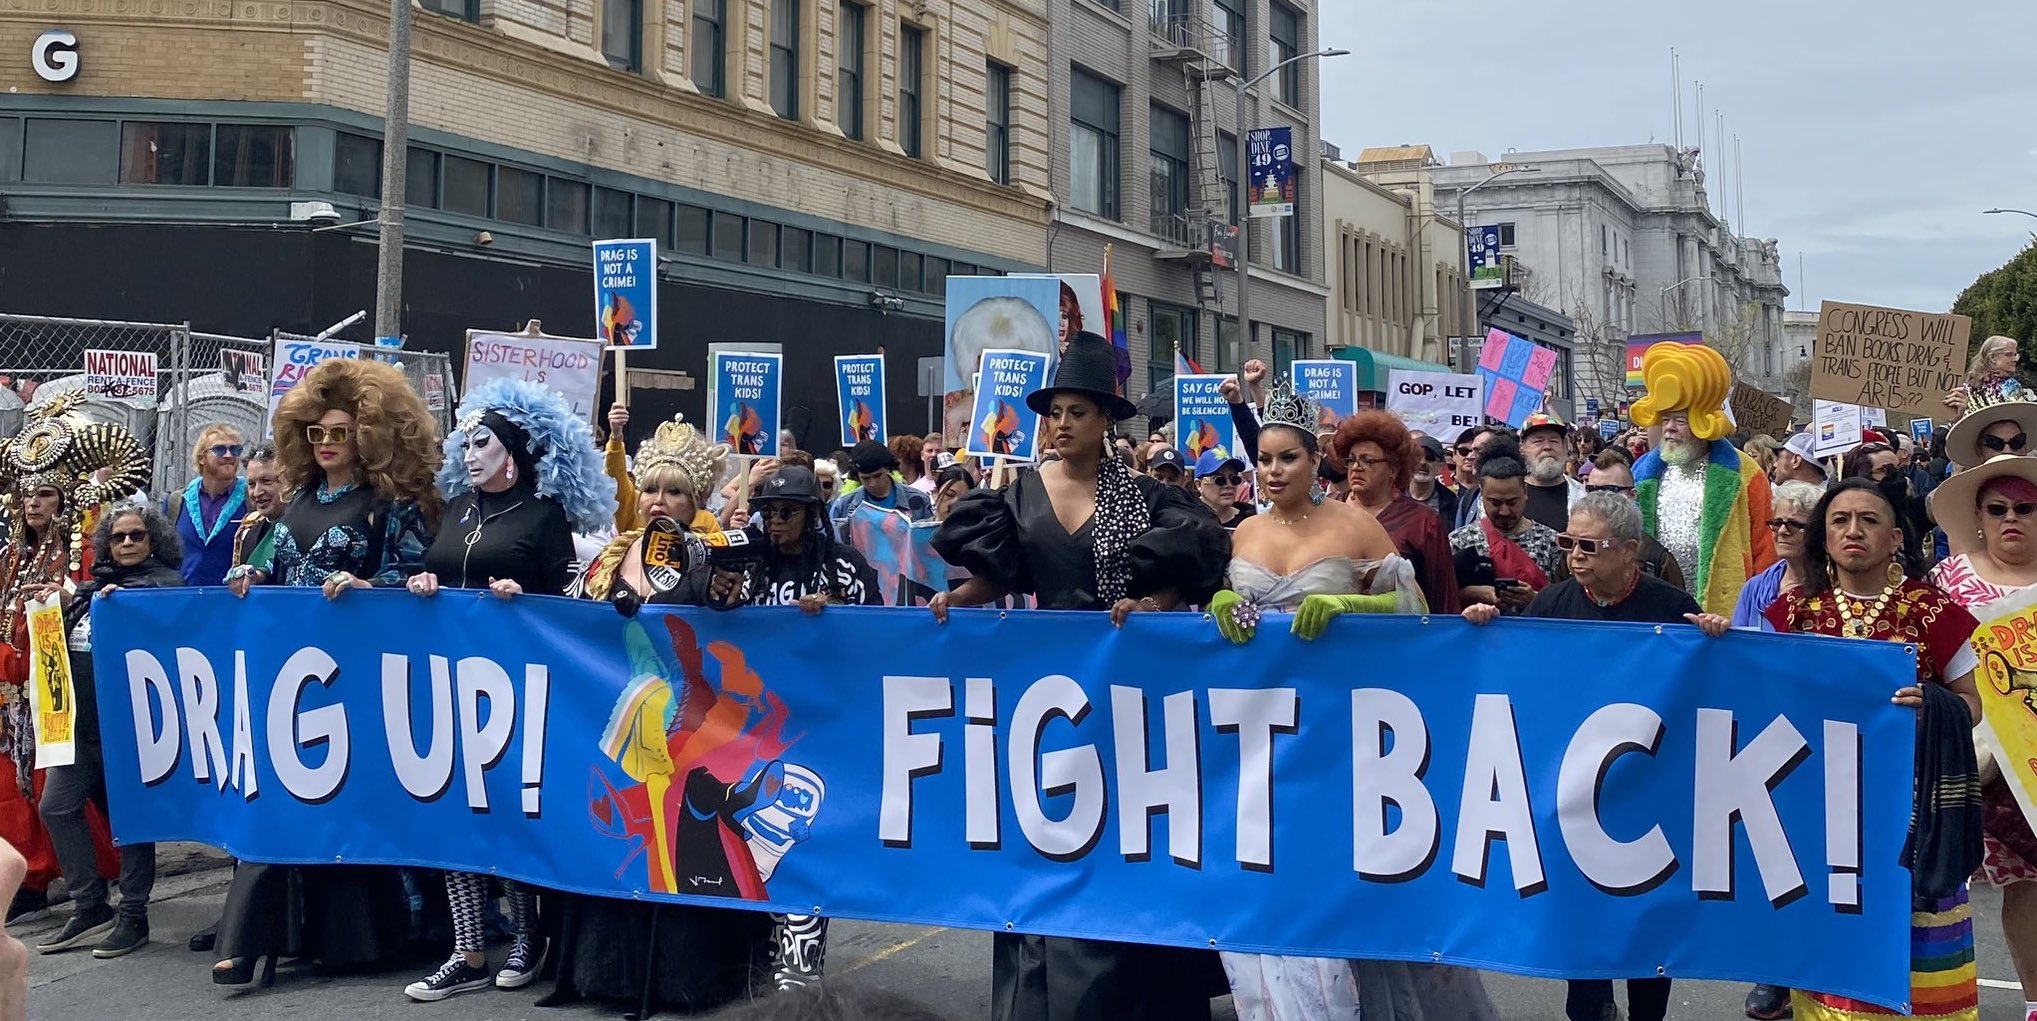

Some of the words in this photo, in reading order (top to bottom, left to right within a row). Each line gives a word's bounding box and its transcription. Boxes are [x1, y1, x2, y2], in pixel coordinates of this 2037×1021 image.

[32, 29, 79, 82] G
[1250, 141, 1271, 154] DINE
[1251, 153, 1272, 167] 49
[600, 249, 624, 261] DRAG
[627, 248, 638, 260] IS
[603, 263, 622, 275] NOT
[625, 262, 633, 274] A
[602, 276, 636, 288] CRIME!
[1827, 308, 1912, 339] CONGRESS
[1921, 317, 1956, 345] WILL
[472, 341, 588, 370] SISTERHOOD
[1825, 333, 1857, 356] BAN
[1906, 343, 1940, 367] DRAG
[87, 352, 155, 377] NATIONAL
[725, 361, 770, 374] PROTECT
[842, 363, 875, 374] PROTECT
[989, 357, 1035, 373] PROTECT
[524, 370, 547, 383] IS
[993, 371, 1027, 385] TRANS
[1304, 367, 1330, 378] DRAG
[1332, 367, 1342, 378] IS
[1822, 356, 1862, 379] TRANS
[1867, 362, 1902, 385] PEOPLE
[1907, 367, 1932, 387] BUT
[1935, 373, 1962, 392] NOT
[87, 376, 155, 386] RENT-A-FENCE
[731, 374, 764, 387] TRANS
[847, 374, 872, 385] TRANS
[1308, 379, 1329, 389] NOT
[1331, 379, 1338, 389] A
[734, 387, 762, 400] KIDS!
[850, 386, 871, 396] KIDS!
[994, 384, 1023, 398] KIDS!
[1182, 383, 1203, 394] SAY
[1204, 383, 1219, 394] GA
[1399, 382, 1437, 399] GOP,
[1445, 386, 1477, 399] LET
[1181, 396, 1194, 404] WE
[1195, 396, 1213, 405] WILL
[1181, 406, 1191, 415] BE
[1191, 406, 1229, 416] SILENCED!
[1451, 414, 1479, 428] BE!
[124, 645, 350, 803] DRAG
[381, 651, 551, 819] UP!
[877, 674, 1300, 872] FIGHT
[1351, 687, 1864, 915] BACK!
